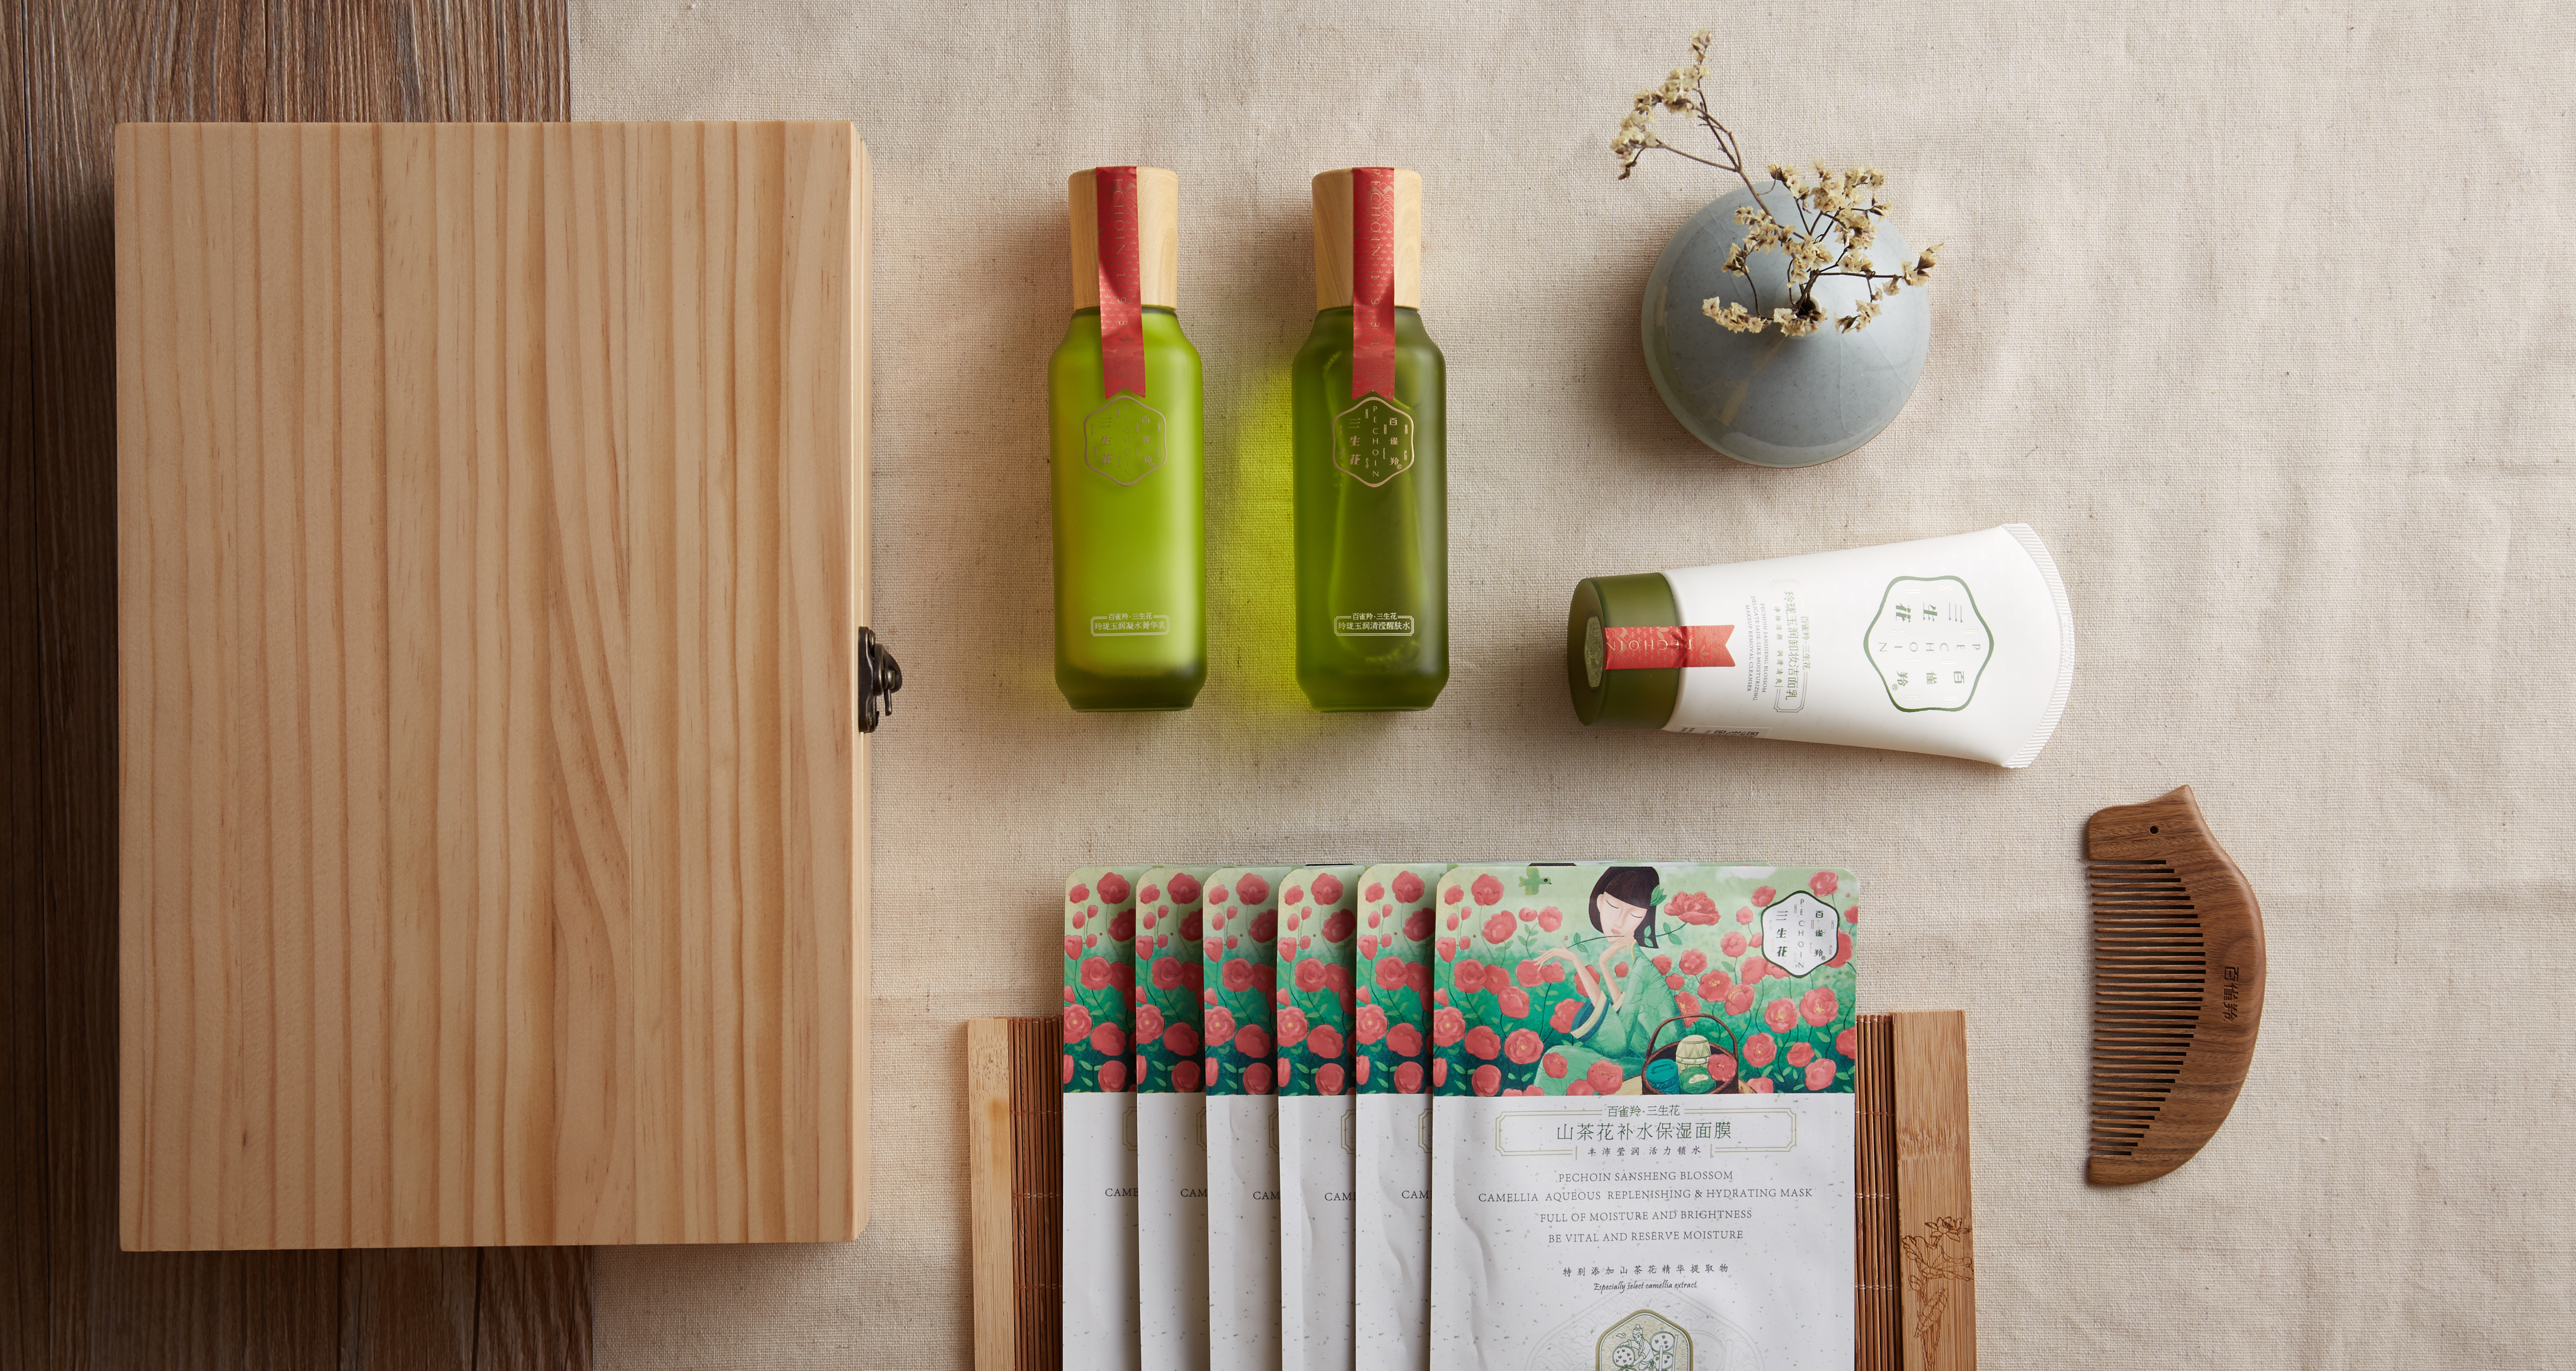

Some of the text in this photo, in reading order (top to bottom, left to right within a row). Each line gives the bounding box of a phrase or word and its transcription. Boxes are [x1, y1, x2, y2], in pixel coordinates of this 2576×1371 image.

[1370, 168, 1381, 256] PECHOIN
[1348, 418, 1361, 465] 三生花
[1389, 417, 1400, 465] 百雀羚
[1751, 596, 1760, 623] DELICATE
[1895, 602, 1963, 623] 三生花
[1784, 591, 1800, 700] 玲珑玉润卸妆洁面乳
[1878, 642, 1981, 652] PECHOIN
[1896, 671, 1965, 687] 百雀羚
[1775, 910, 1788, 957] 三生花
[1814, 910, 1824, 956] 百雀羚
[2223, 966, 2239, 1022] 百雀羚
[1557, 1122, 1731, 1140] 山茶花补水保湿面膜
[1559, 1171, 1733, 1182] PECHOIN SANSHENG BLOSSOM
[1402, 1190, 1432, 1199] CAM
[1479, 1193, 1539, 1202] CAMELLIA
[1545, 1191, 1601, 1202] AQUEOUS
[1608, 1189, 1691, 1200] REPLENISHING
[1706, 1189, 1776, 1198] HYDRATING
[1780, 1188, 1813, 1197] MASK
[1540, 1210, 1752, 1222] FULL OF MOISTURE AND BRIGHTNESS
[1549, 1230, 1743, 1243] BE VITAL AND RESERVE MOISTURE
[1563, 1263, 1728, 1277] 特别添加山茶花精华提取物
[1594, 1279, 1697, 1294] Especially select camellia extract
